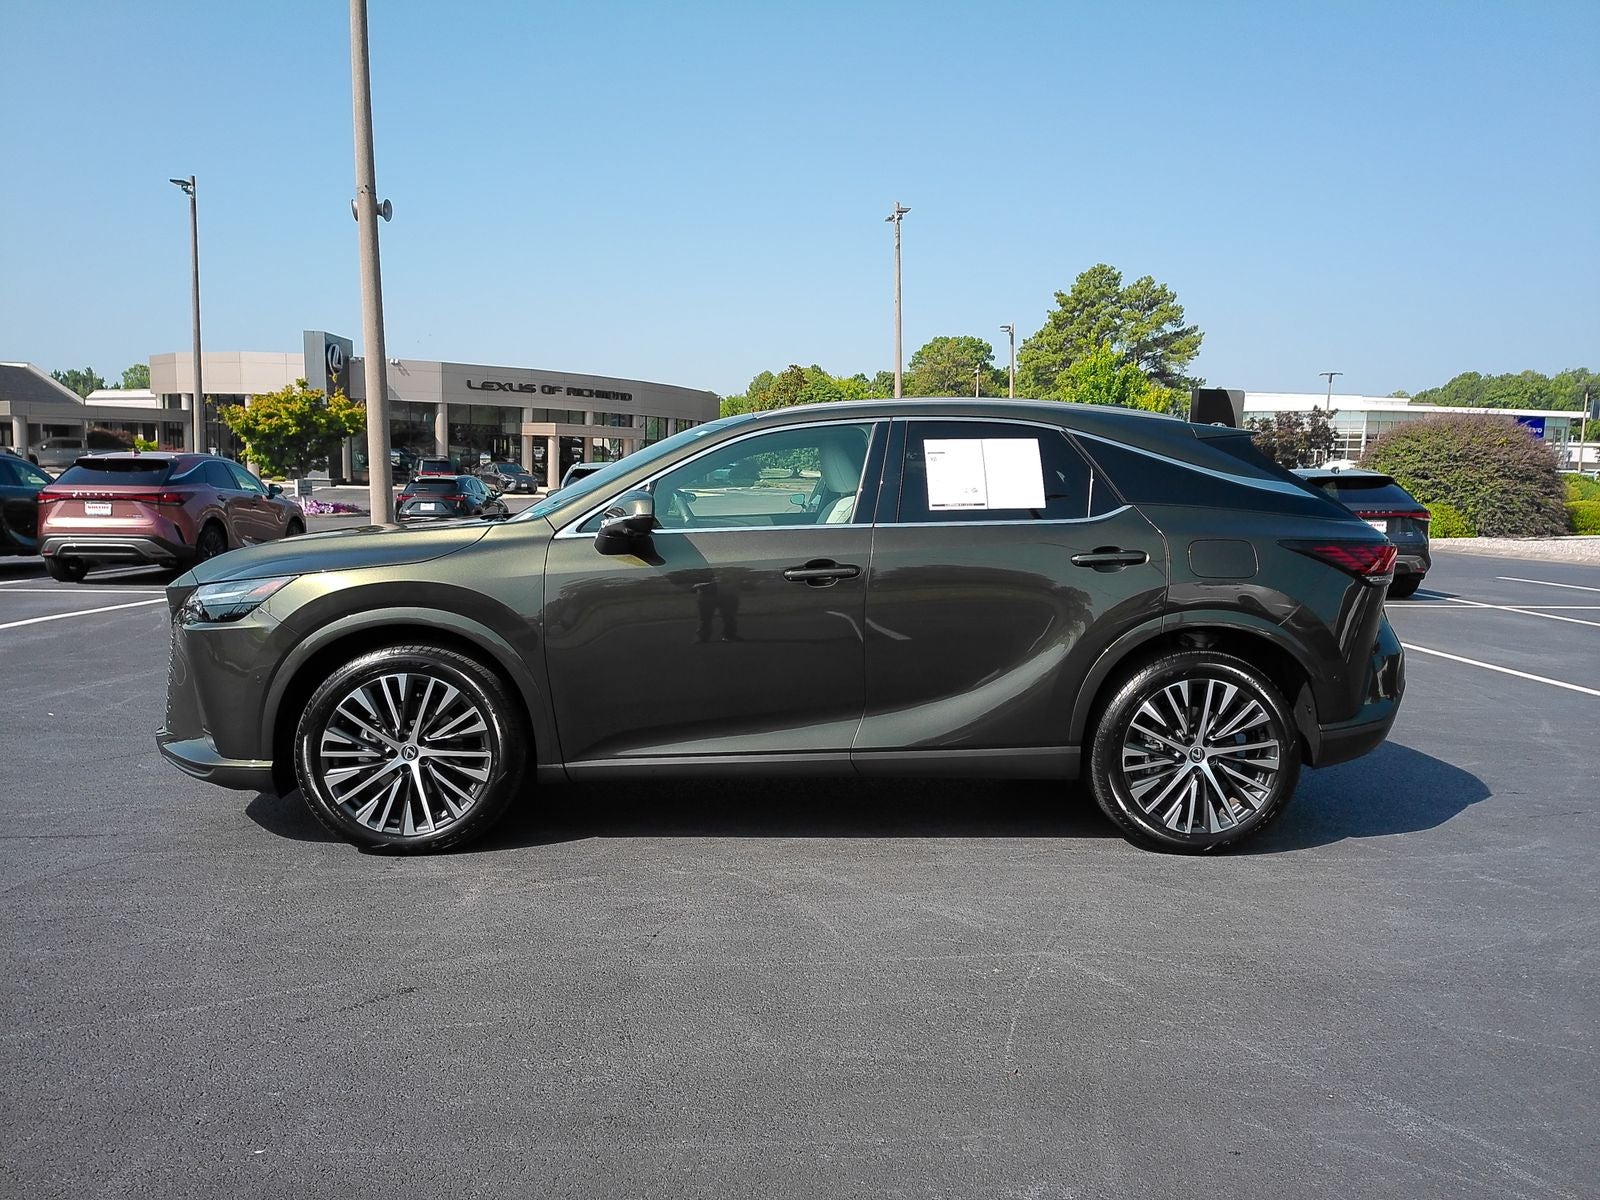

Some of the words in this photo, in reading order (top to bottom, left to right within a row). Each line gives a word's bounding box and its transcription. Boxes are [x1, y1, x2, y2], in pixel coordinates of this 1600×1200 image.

[467, 380, 537, 393] LEXUS
[541, 385, 563, 395] OF
[567, 387, 632, 401] RICHMOND
